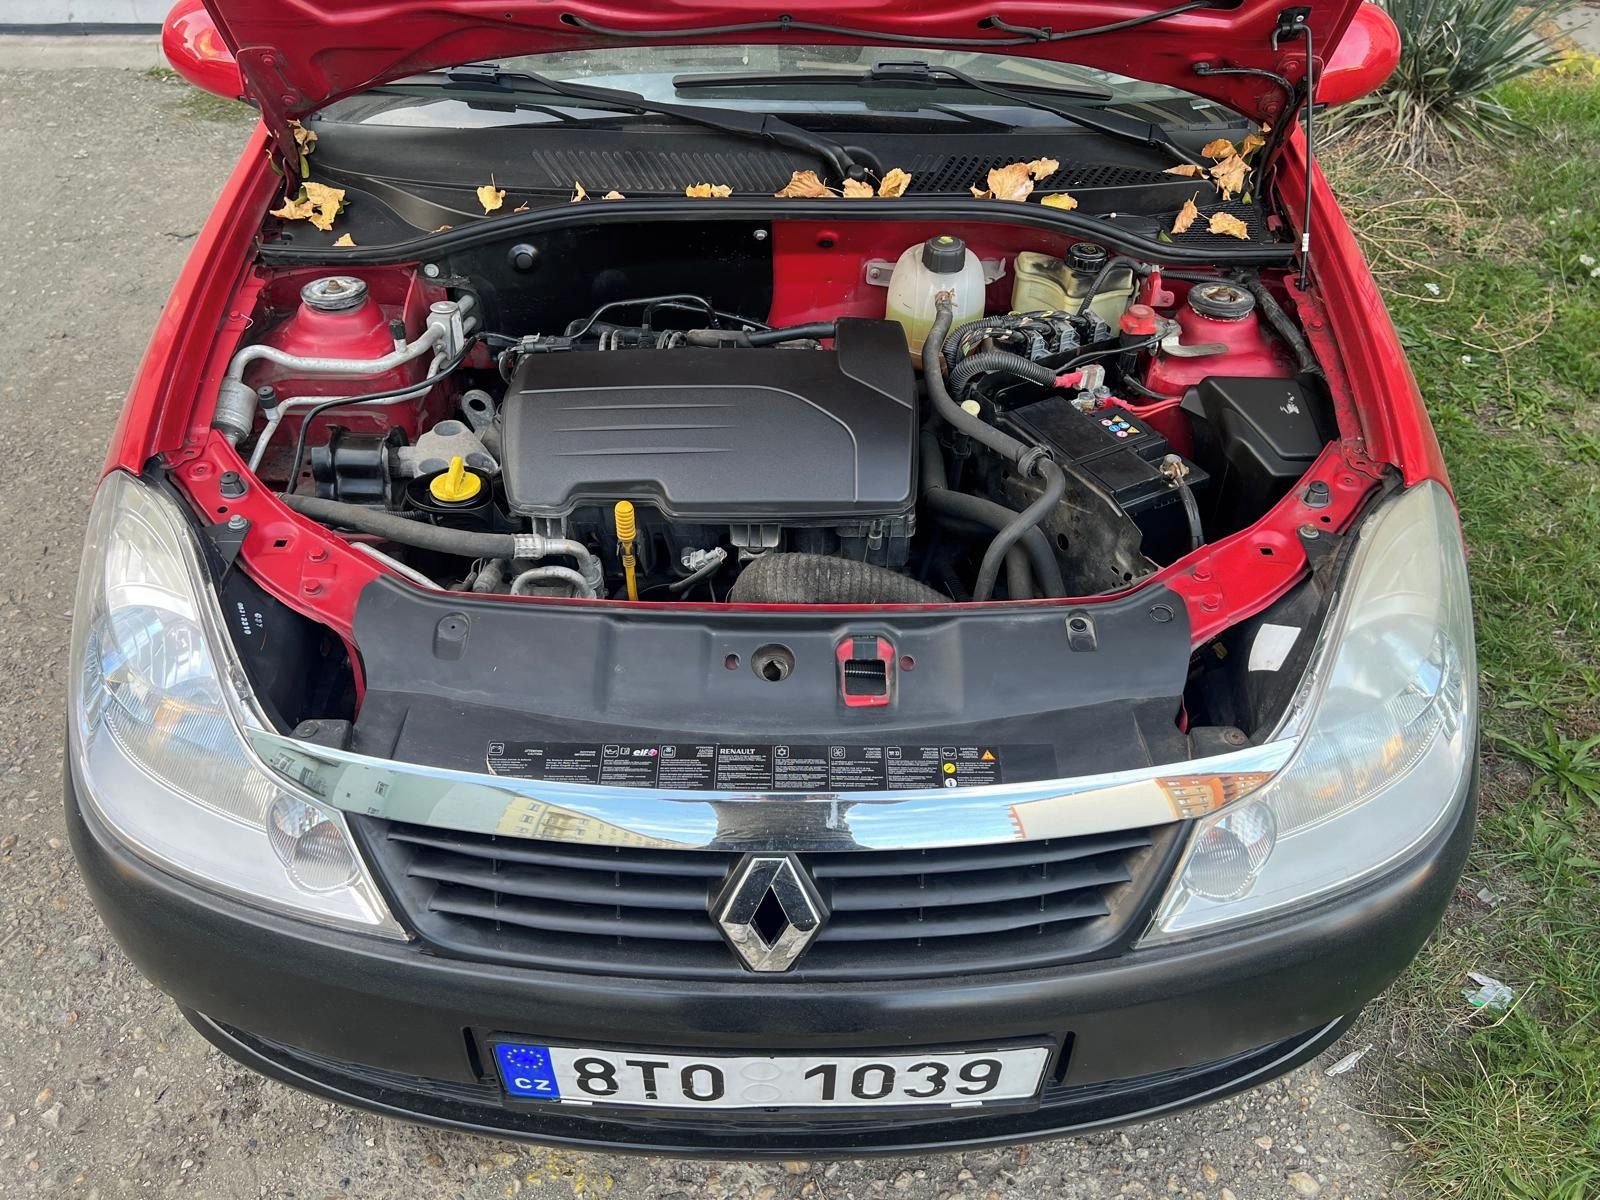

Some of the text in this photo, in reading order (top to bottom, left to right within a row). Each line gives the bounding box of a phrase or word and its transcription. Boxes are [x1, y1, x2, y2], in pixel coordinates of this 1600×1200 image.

[632, 748, 649, 757] elf
[514, 1077, 552, 1091] CZ
[804, 1058, 1003, 1101] 1039
